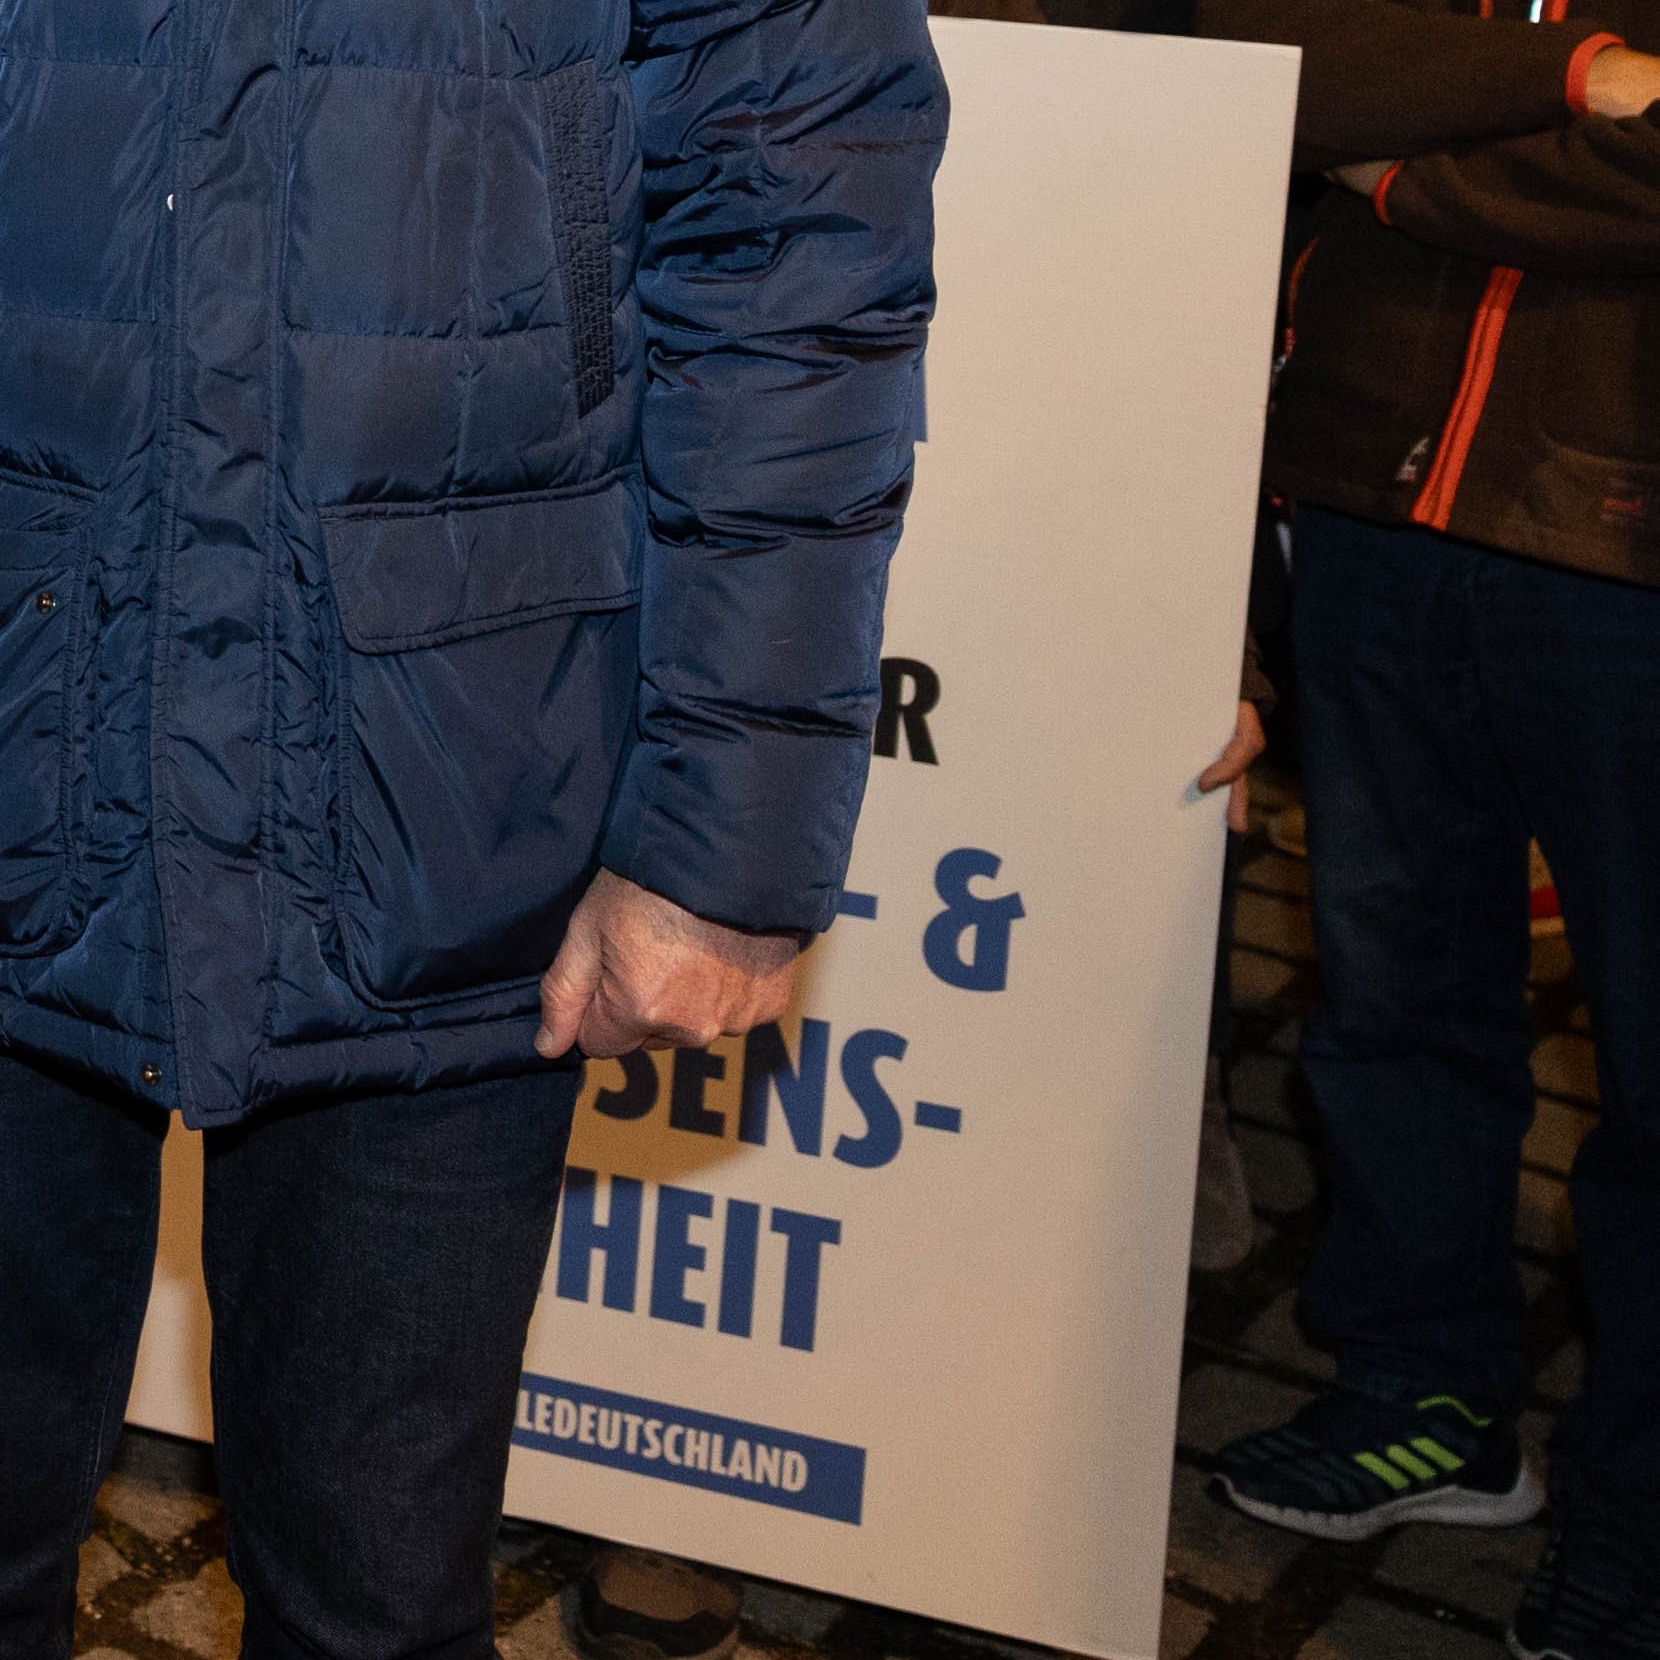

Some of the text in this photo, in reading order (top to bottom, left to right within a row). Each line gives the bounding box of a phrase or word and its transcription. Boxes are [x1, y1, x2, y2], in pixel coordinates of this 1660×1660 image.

[924, 848, 1025, 991] &
[580, 1017, 961, 1168] SENS-
[515, 1388, 808, 1494] LEDEUTSCHLAND
